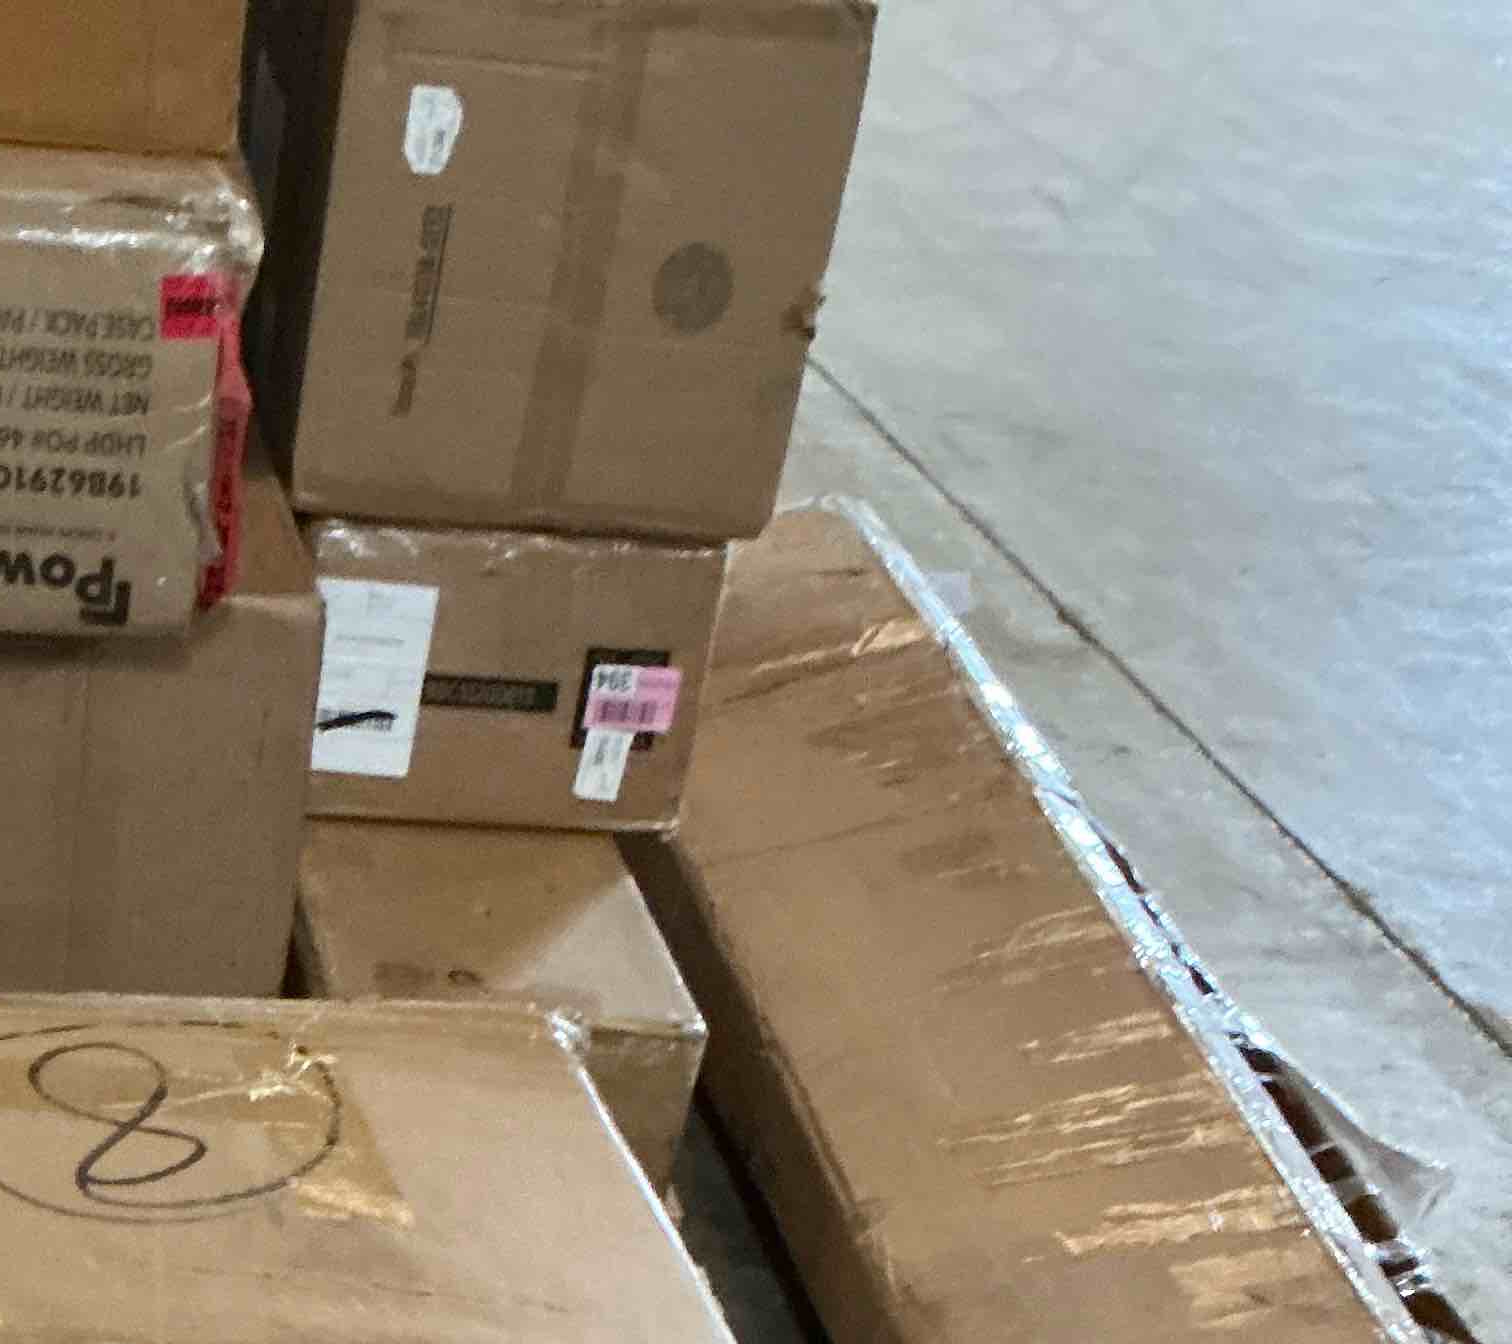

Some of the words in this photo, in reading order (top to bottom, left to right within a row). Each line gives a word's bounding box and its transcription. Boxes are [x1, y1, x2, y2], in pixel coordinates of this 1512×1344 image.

[23, 385, 104, 415] WEIGHT
[109, 389, 152, 417] NET
[27, 1041, 208, 1194] 8
